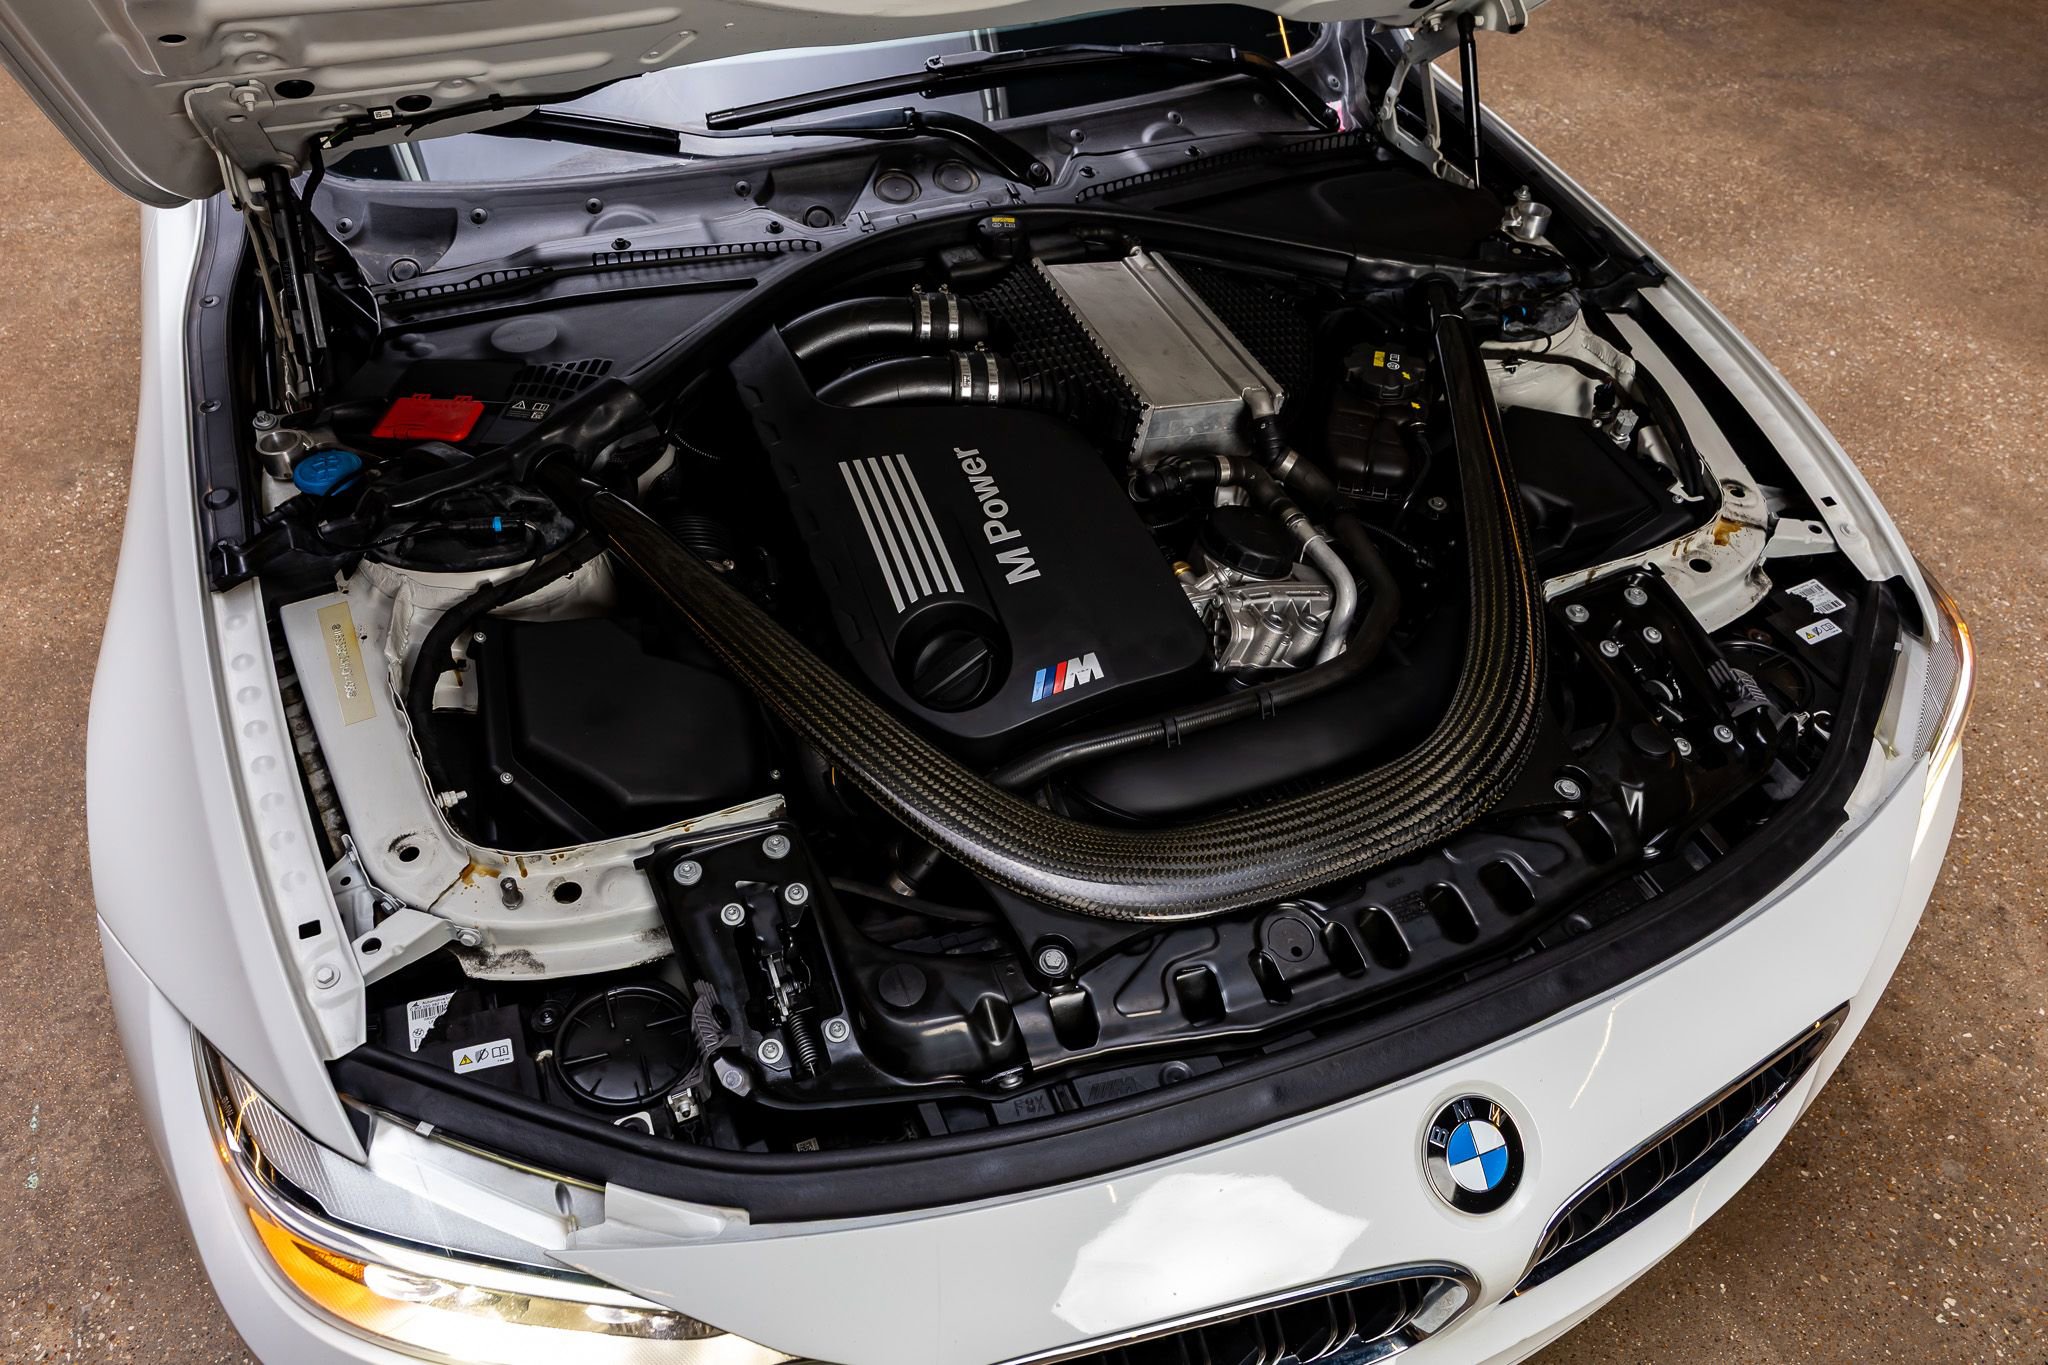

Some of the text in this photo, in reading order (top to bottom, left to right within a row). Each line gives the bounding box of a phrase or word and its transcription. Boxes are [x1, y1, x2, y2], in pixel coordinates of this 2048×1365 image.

[953, 447, 1041, 584] M Power
[1429, 1099, 1507, 1149] BMW
